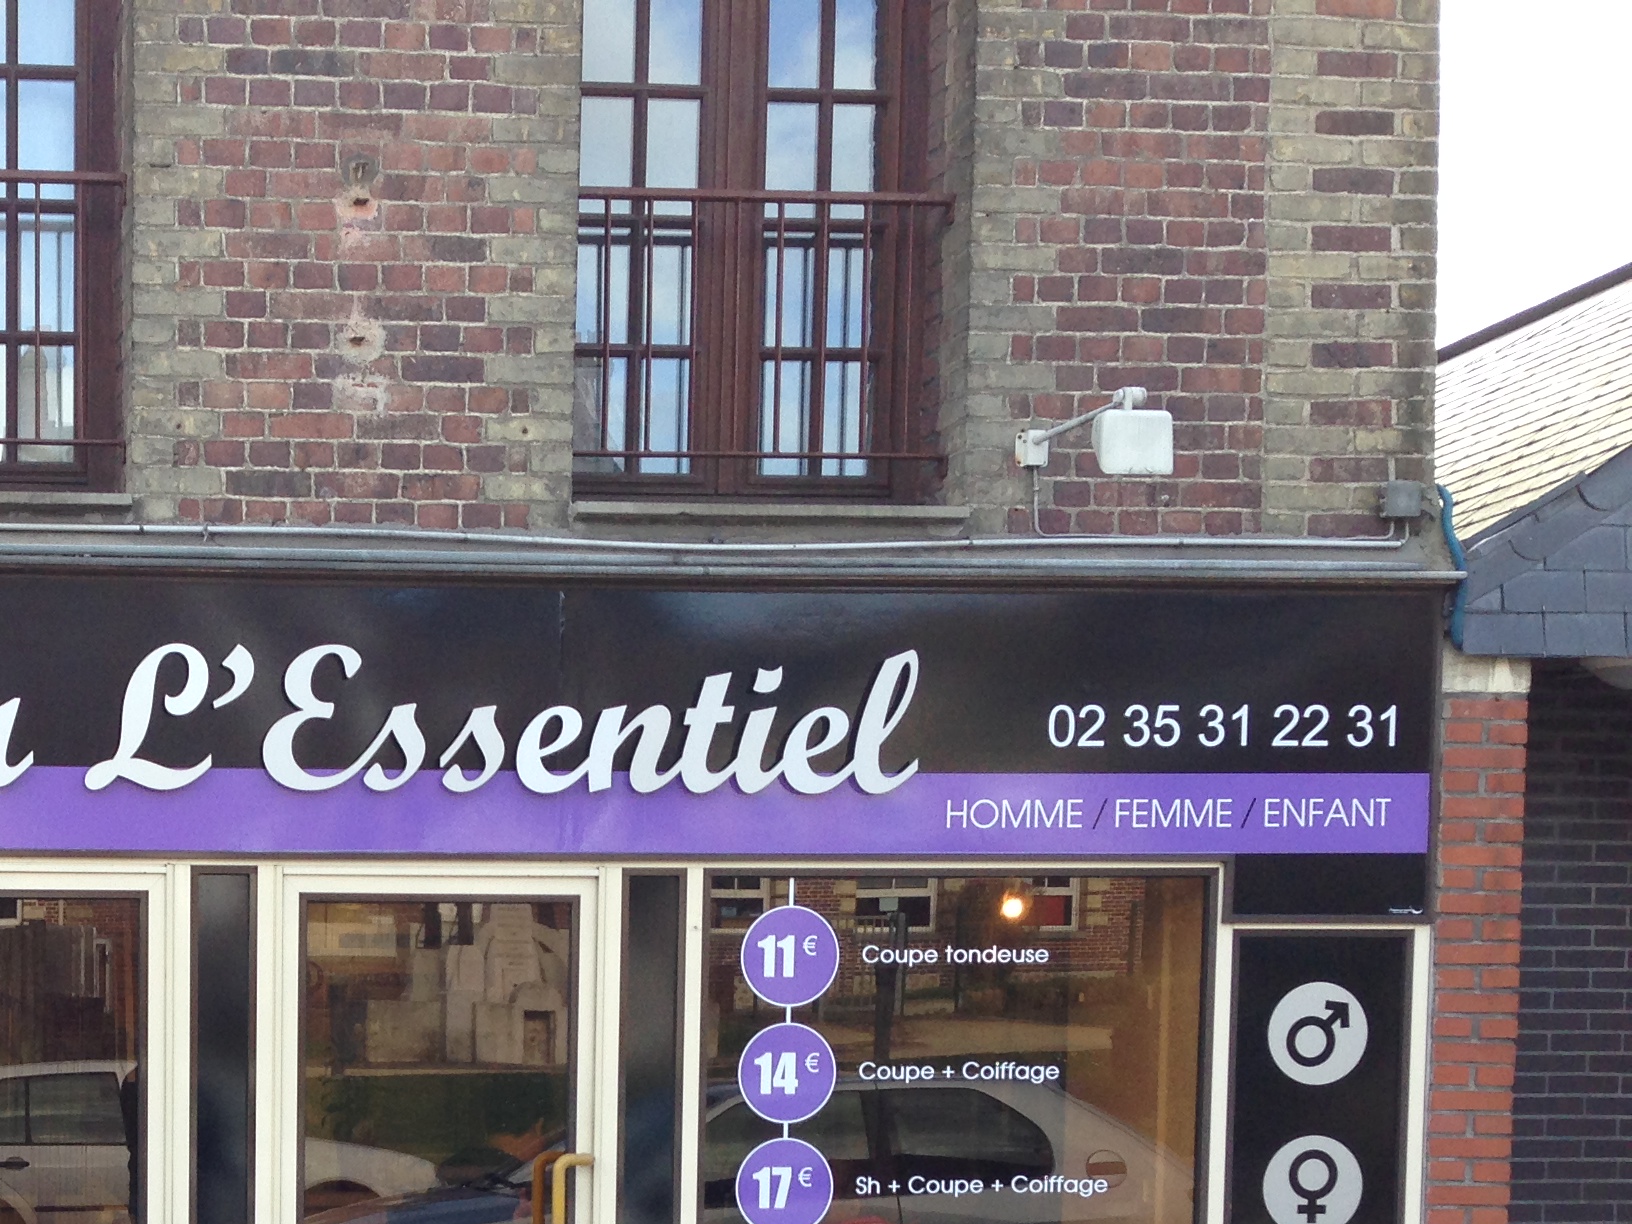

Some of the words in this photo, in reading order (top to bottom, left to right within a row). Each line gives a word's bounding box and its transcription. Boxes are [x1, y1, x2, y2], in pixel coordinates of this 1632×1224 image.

[83, 642, 920, 796] L'Essentiel
[1048, 704, 1106, 748] 02
[1123, 704, 1181, 748] 35
[1198, 704, 1249, 747] 31
[1271, 704, 1330, 747] 22
[1347, 704, 1397, 748] 31
[945, 798, 1084, 830] HOMME
[1114, 797, 1234, 829] FEMME
[1263, 797, 1392, 828] ENFANT
[861, 944, 939, 969] Coupe
[945, 944, 1050, 964] tondeuse
[858, 1061, 935, 1084] Coupe
[941, 1065, 955, 1079] +
[962, 1061, 1060, 1085] Coiffage
[855, 1176, 881, 1195] Sh
[888, 1180, 901, 1193] +
[908, 1175, 984, 1198] Coupe
[991, 1179, 1004, 1193] +
[1011, 1175, 1108, 1198] Coiffage
